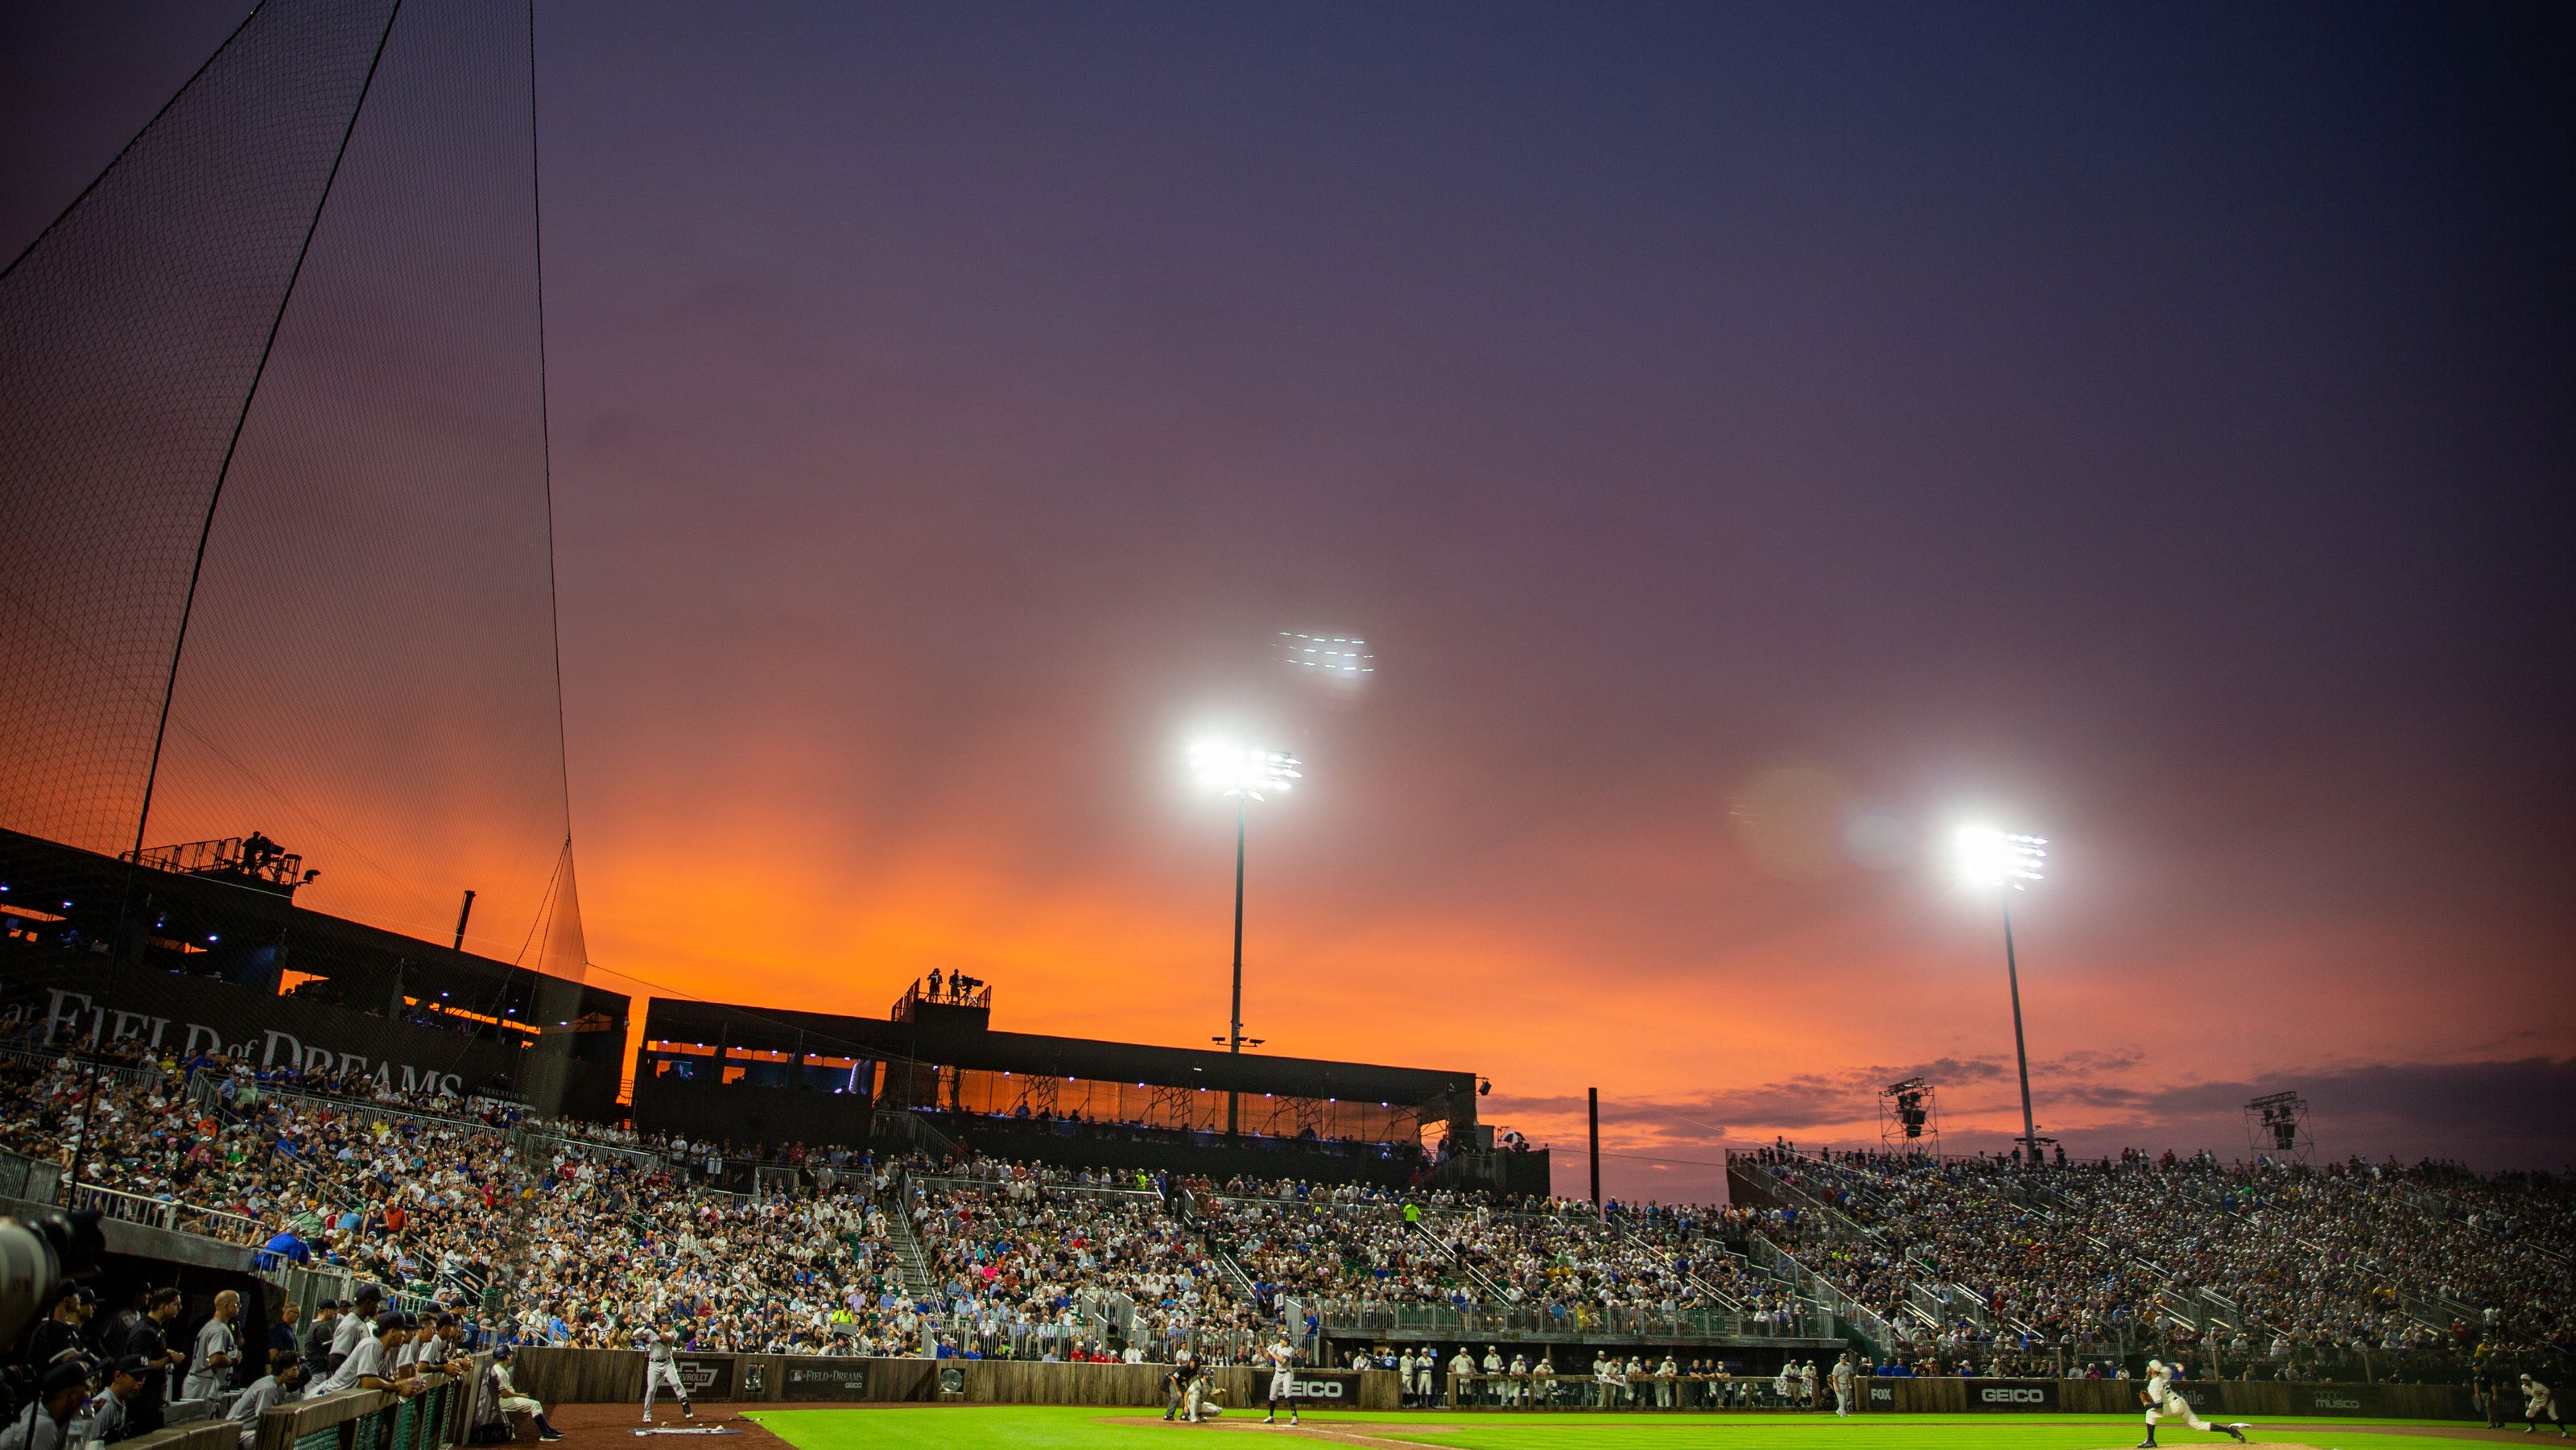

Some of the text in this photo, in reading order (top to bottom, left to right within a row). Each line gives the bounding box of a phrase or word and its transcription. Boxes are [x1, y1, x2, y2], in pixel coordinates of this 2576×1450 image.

[226, 1039, 259, 1061] of
[679, 1373, 709, 1382] EVROLET
[806, 1369, 828, 1382] FIELD
[833, 1369, 864, 1382] DREAMS
[1278, 1381, 1343, 1398] EICO
[1870, 1388, 1893, 1401] FOX
[1981, 1388, 2045, 1402] GEICO
